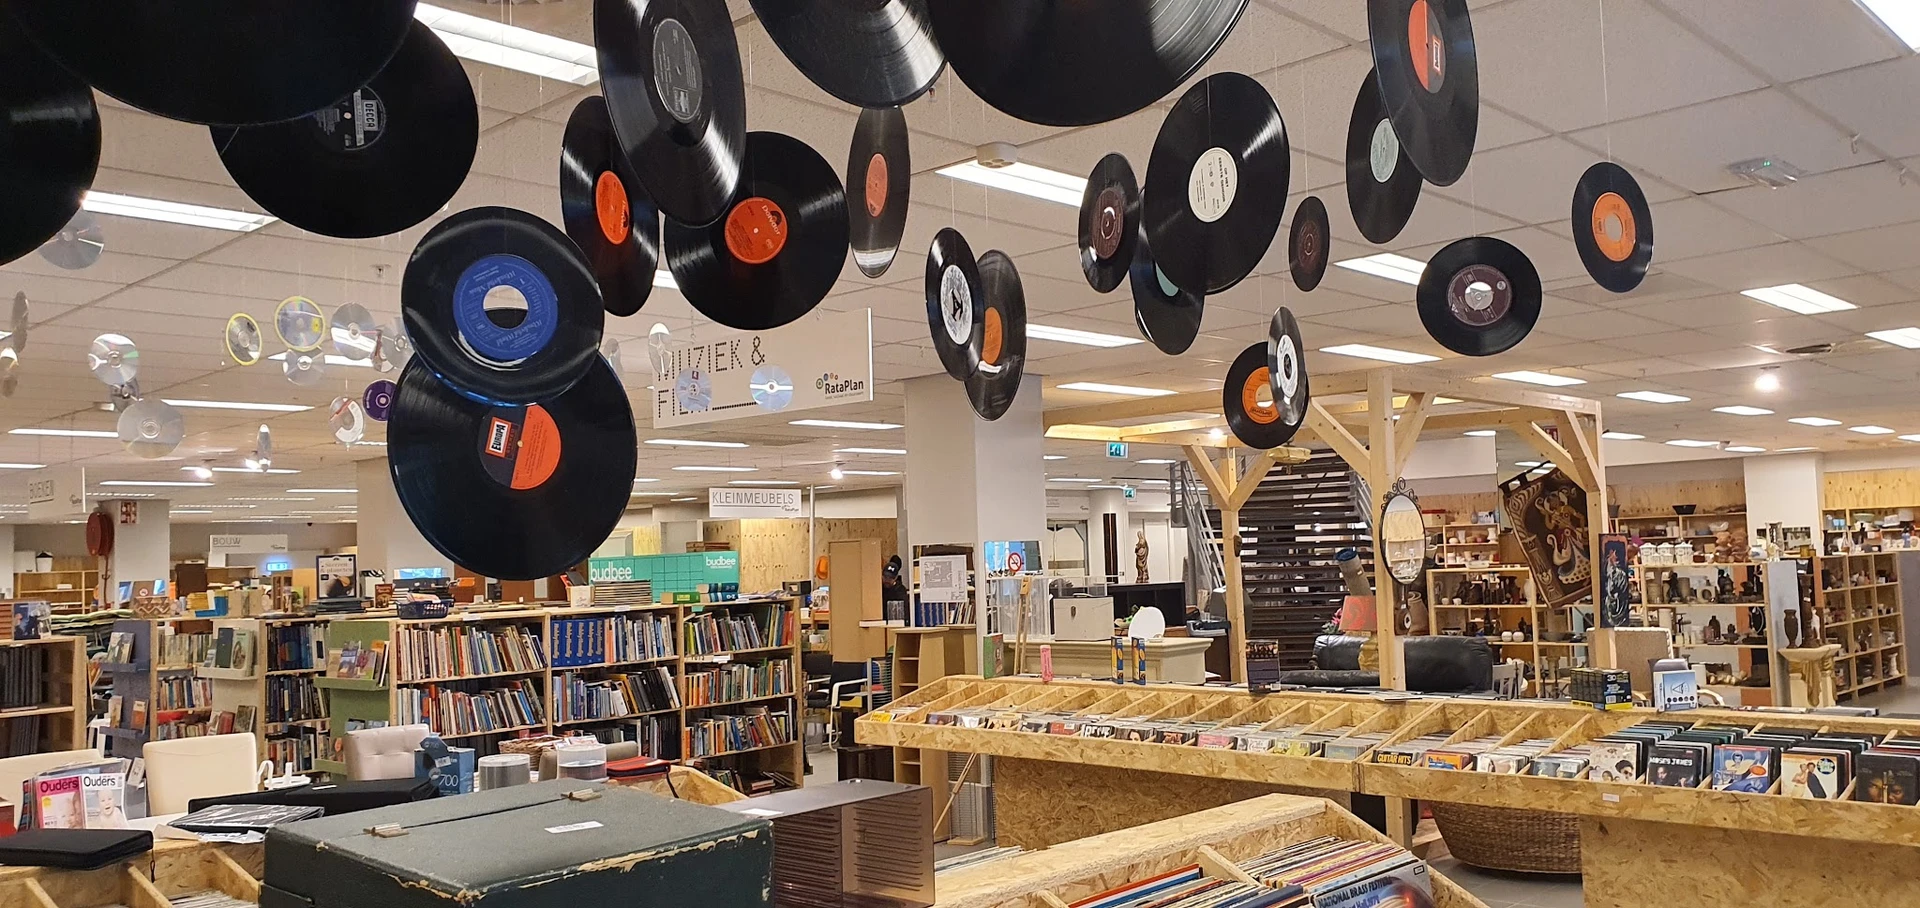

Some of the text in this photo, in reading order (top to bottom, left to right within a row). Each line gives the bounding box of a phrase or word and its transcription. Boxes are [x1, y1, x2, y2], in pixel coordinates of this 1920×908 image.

[365, 103, 375, 128] DECCA
[761, 205, 780, 235] Polydor
[751, 336, 765, 365] &
[824, 379, 864, 395] RataPlan
[491, 423, 507, 452] EUROPA
[712, 491, 794, 504] KLEINMEUBELS
[212, 537, 241, 545] BOUW
[705, 556, 736, 566] budbee
[590, 561, 632, 580] budbee
[1378, 753, 1412, 765] GUITAR HITS
[40, 777, 79, 793] Ouders
[83, 776, 116, 787] Ouders
[440, 774, 458, 787] 700
[1318, 889, 1351, 908] NATIONAL
[1349, 883, 1369, 899] BRASS
[1368, 875, 1394, 892] FESTIVAL
